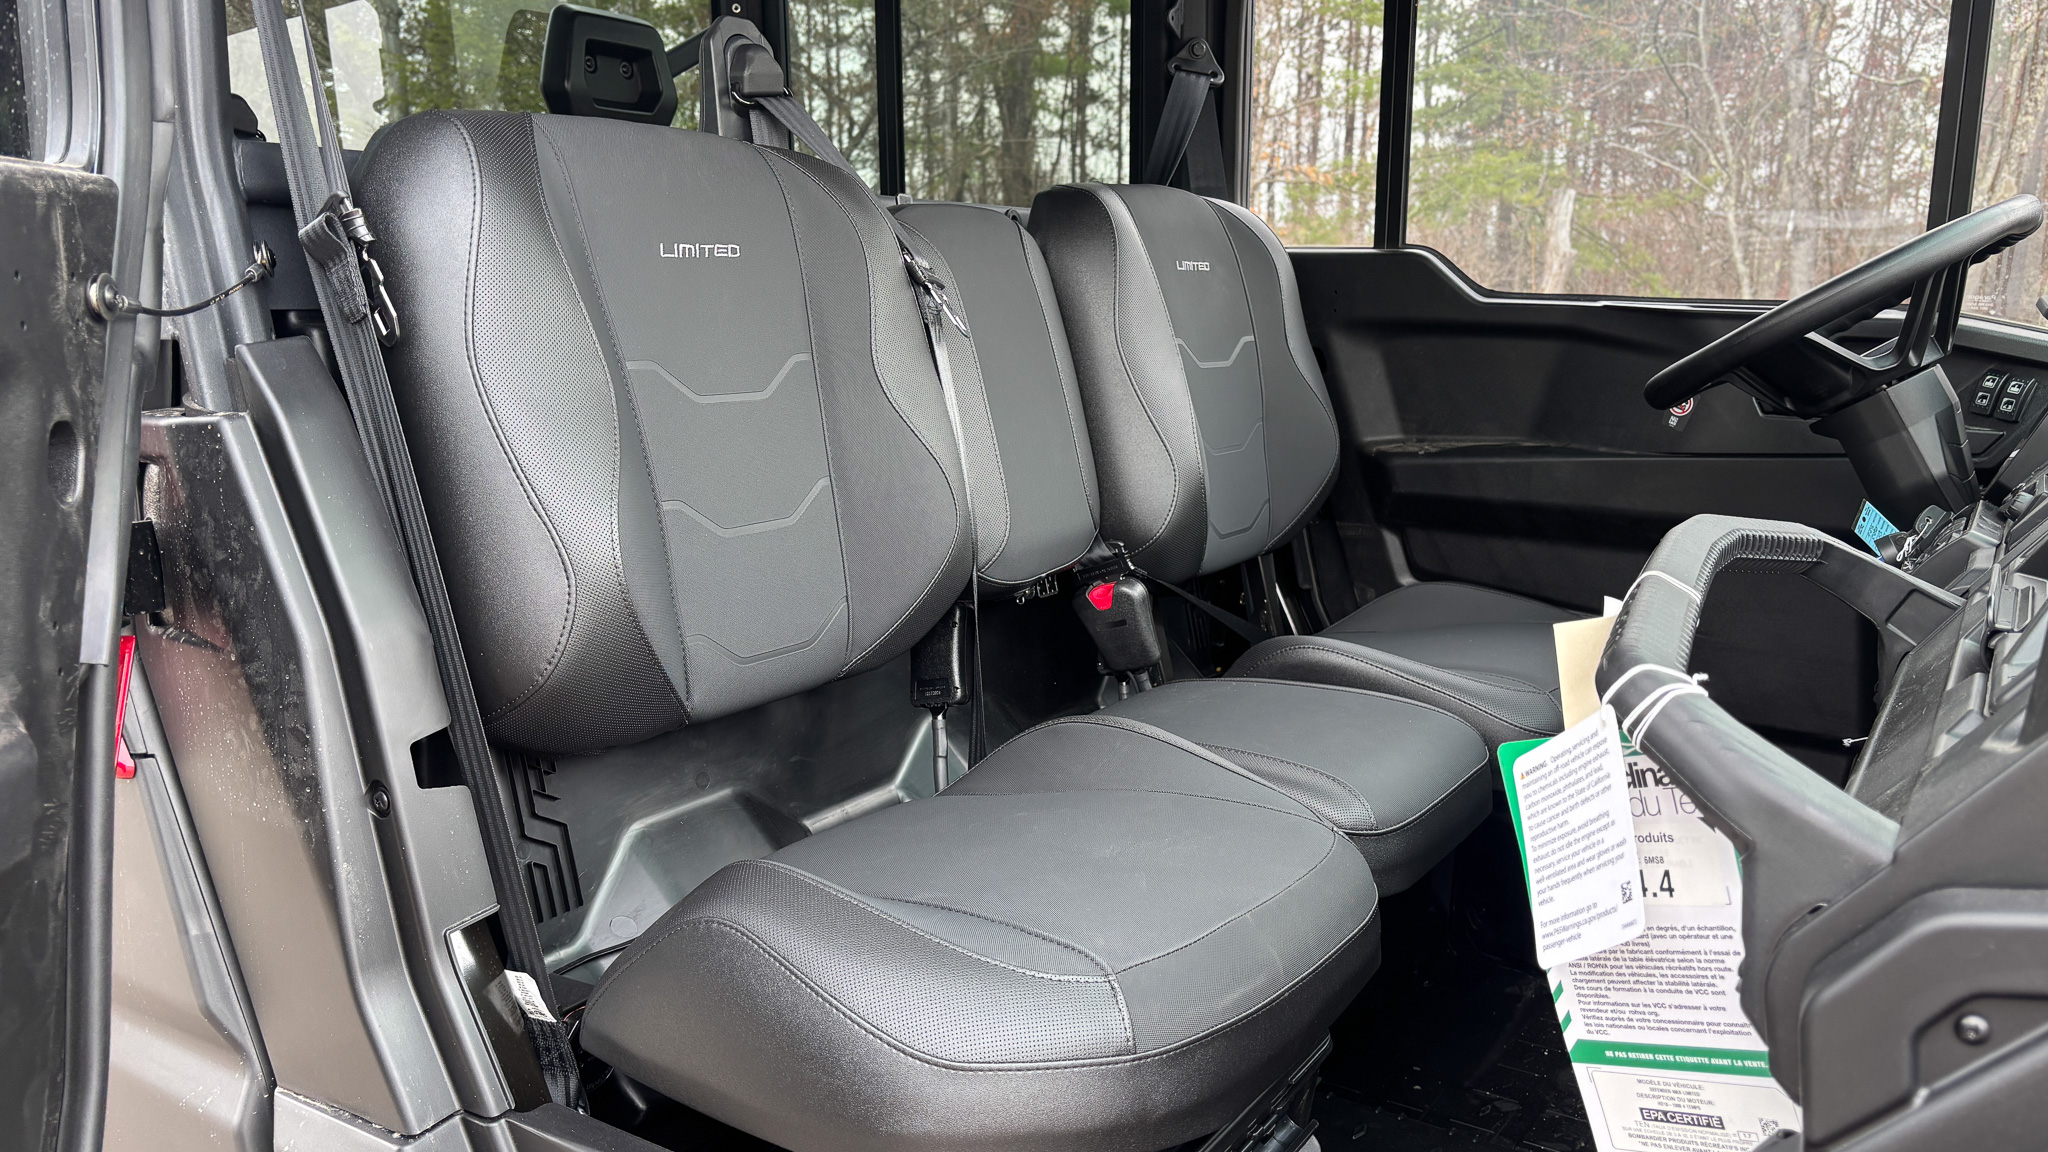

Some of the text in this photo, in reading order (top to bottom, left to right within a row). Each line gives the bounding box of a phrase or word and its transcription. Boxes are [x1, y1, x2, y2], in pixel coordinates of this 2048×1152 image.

[660, 243, 740, 257] LIMITED
[1176, 261, 1210, 271] LIMITED
[1710, 1058, 1732, 1066] AVANT
[1642, 1109, 1722, 1128] EPA CERTIFIÉ
